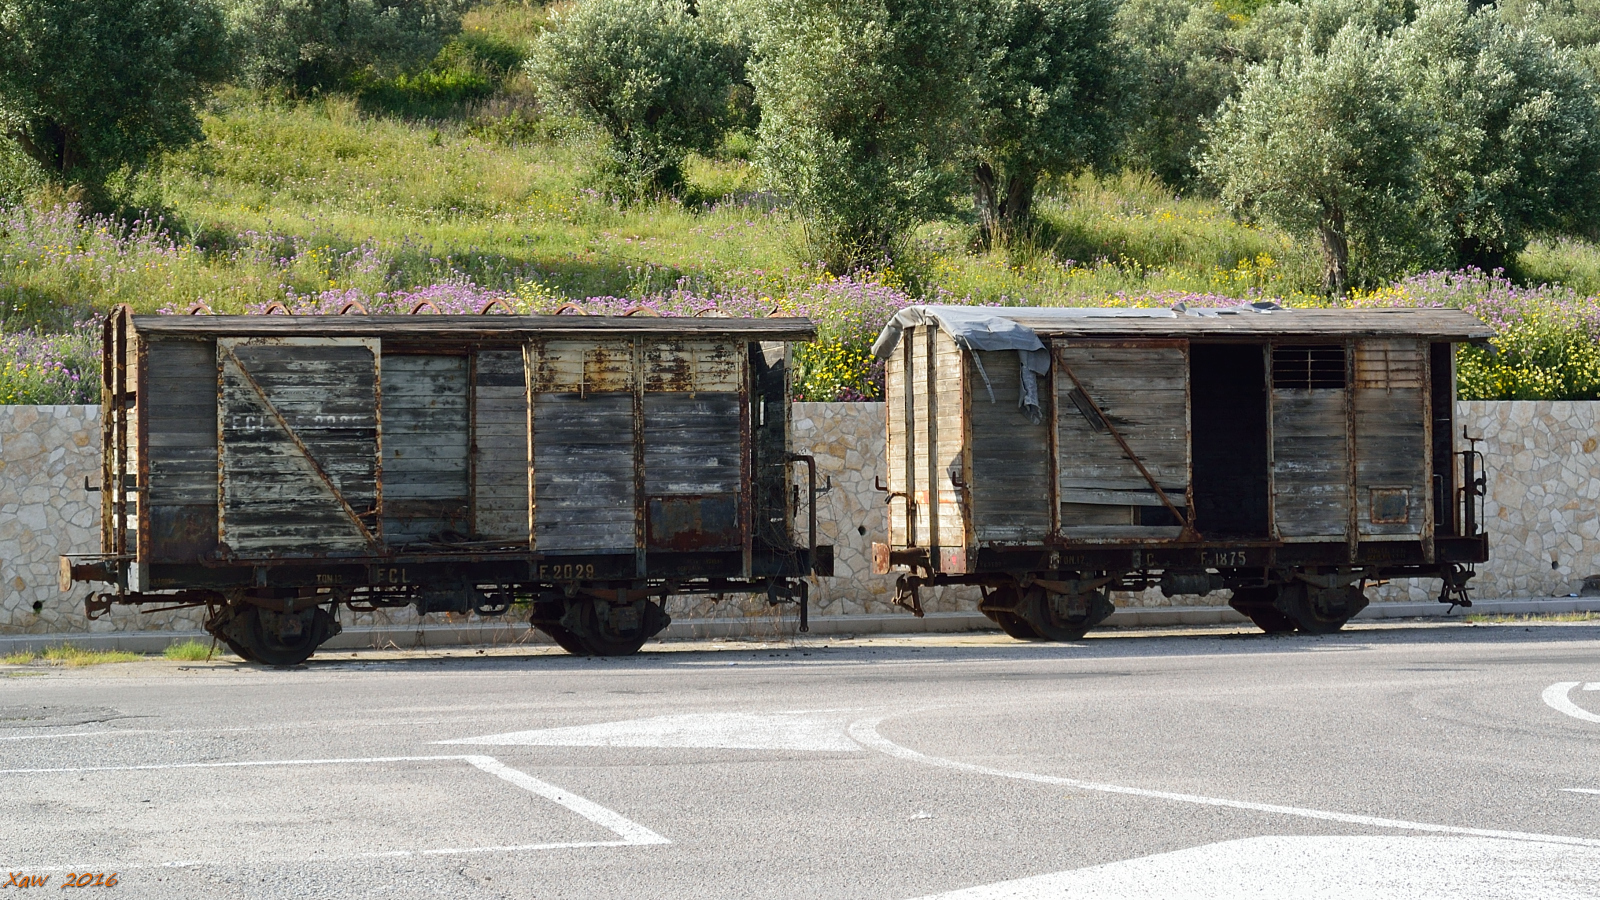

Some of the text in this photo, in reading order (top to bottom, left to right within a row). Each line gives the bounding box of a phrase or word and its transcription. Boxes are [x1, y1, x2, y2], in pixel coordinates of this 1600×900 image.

[1215, 551, 1247, 566] 1875
[316, 574, 333, 583] TON
[377, 568, 410, 584] FCL
[552, 563, 595, 580] 2029
